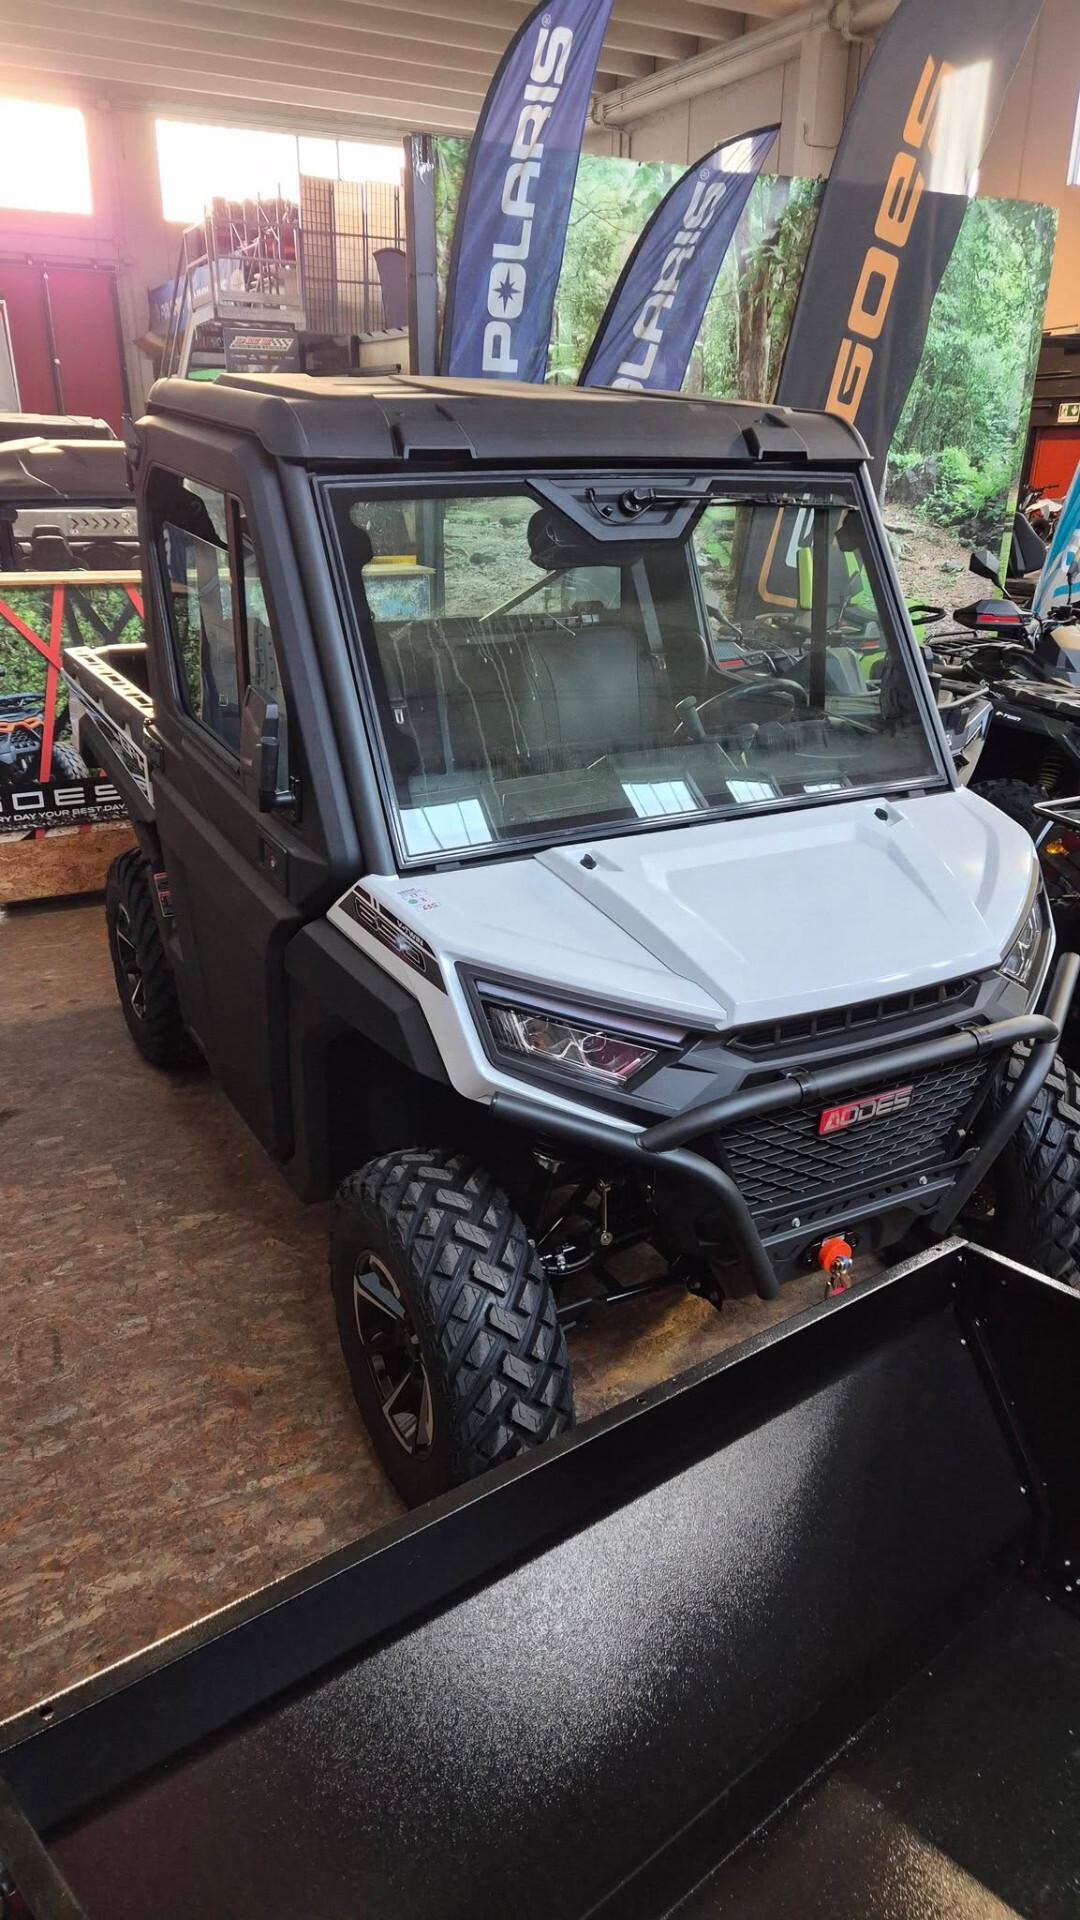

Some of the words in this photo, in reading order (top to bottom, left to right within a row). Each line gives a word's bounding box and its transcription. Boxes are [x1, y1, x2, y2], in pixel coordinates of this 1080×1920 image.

[611, 181, 727, 389] LARIS
[0, 784, 122, 812] OES
[13, 813, 37, 821] DAY
[38, 809, 70, 818] YOUR
